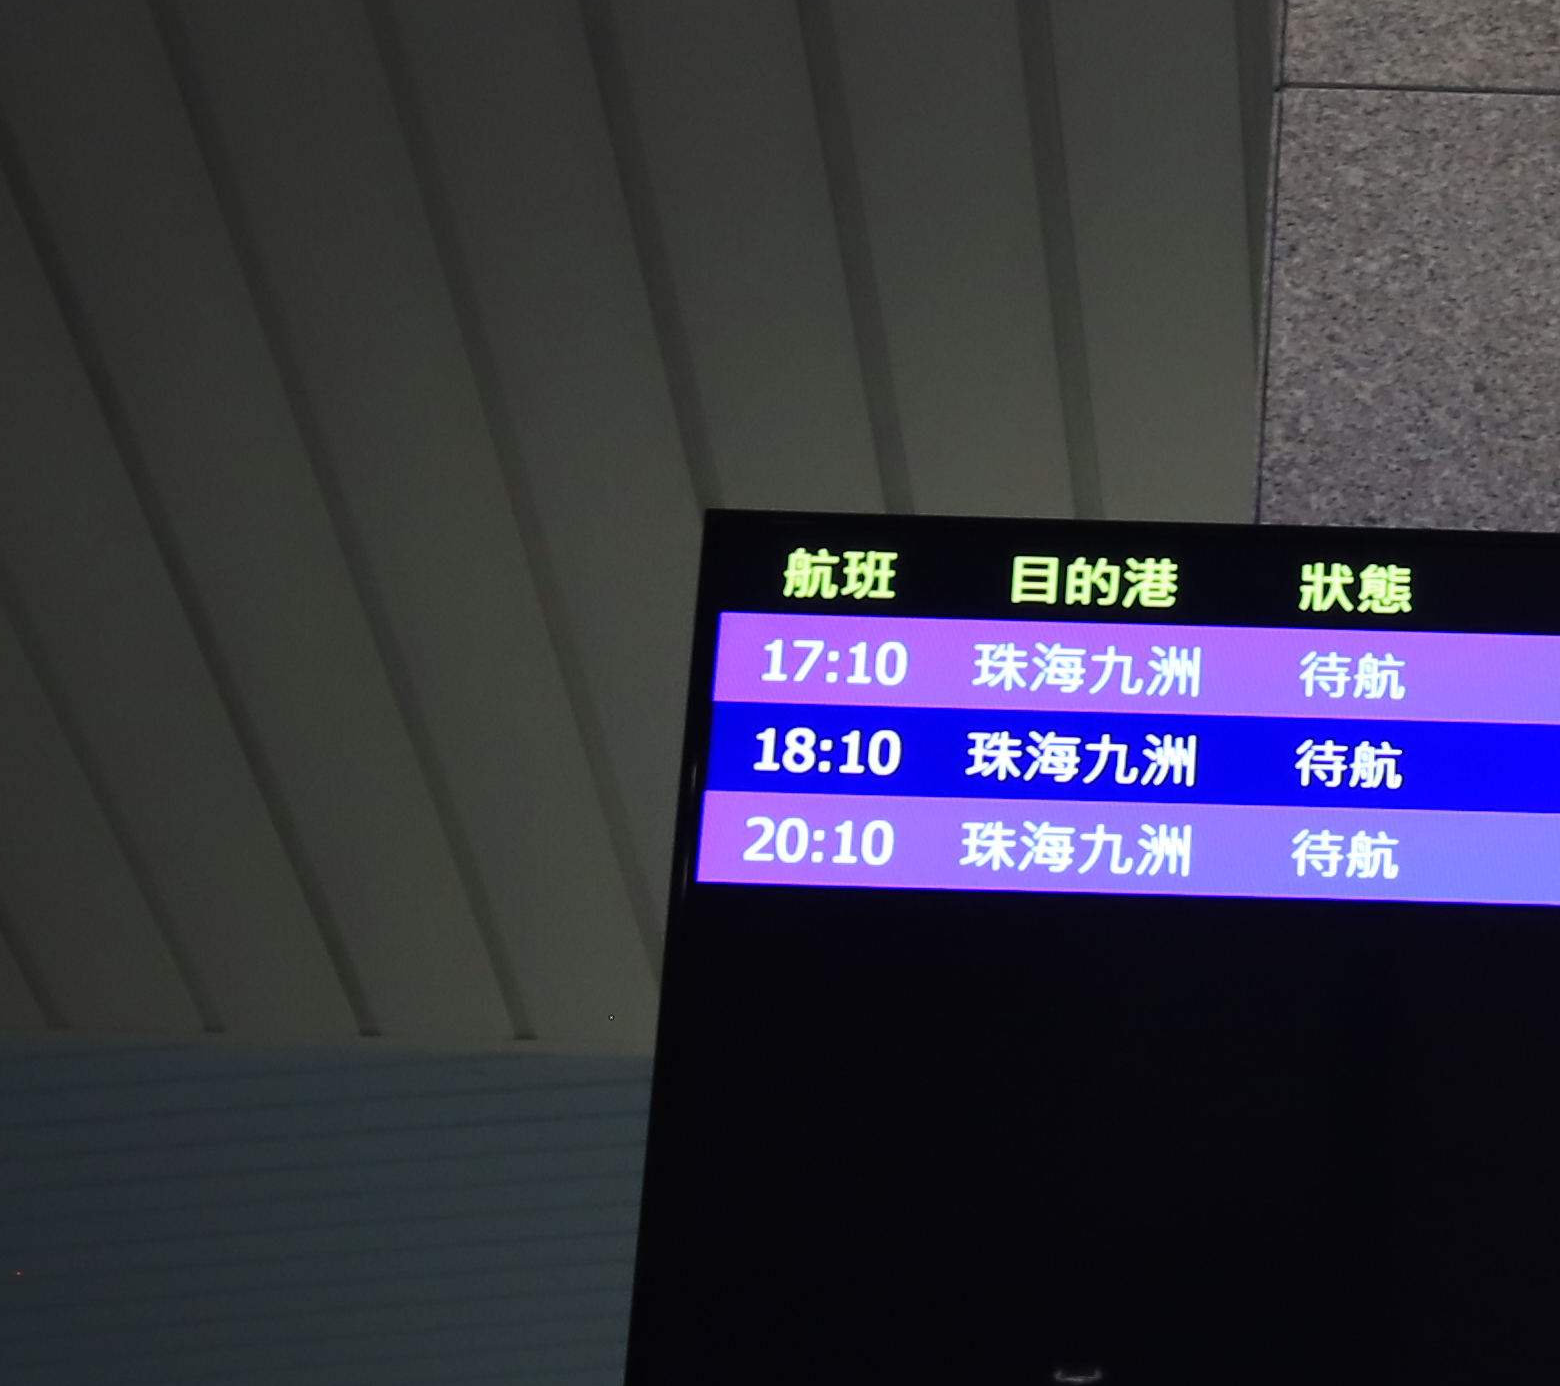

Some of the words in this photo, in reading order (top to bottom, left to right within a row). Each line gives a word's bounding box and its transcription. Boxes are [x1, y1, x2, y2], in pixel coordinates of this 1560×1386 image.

[782, 547, 899, 600] 航班
[1010, 555, 1179, 608] 目的港
[1298, 562, 1413, 614] 狀態
[761, 639, 908, 686] 17:10
[971, 642, 1202, 698] 珠海九洲
[1299, 650, 1406, 700] 待航
[753, 727, 902, 776] 18:10
[964, 730, 1197, 787] 珠海九洲
[1294, 739, 1403, 790] 待航
[742, 816, 895, 866] 20:10
[958, 820, 1192, 878] 珠海九洲
[1290, 828, 1400, 880] 待航
